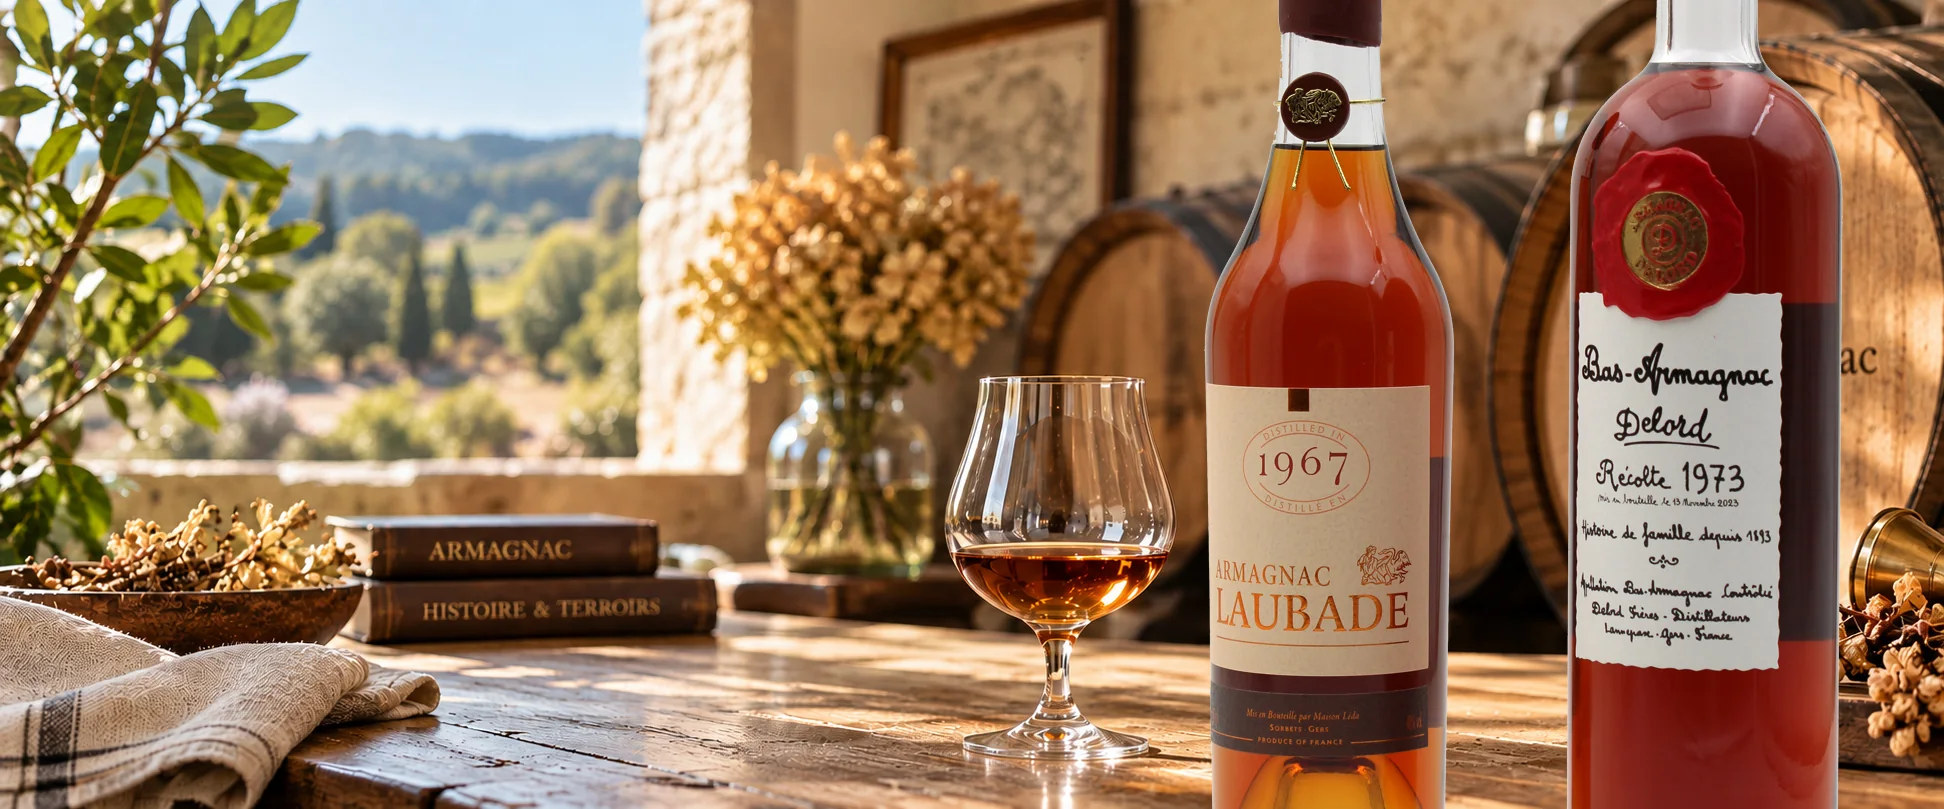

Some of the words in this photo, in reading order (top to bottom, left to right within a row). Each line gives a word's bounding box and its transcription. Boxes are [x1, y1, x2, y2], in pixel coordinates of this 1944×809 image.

[1582, 343, 1773, 402] Bas-Armagnac
[1262, 423, 1325, 441] DISTILLED
[1330, 430, 1346, 442] IN
[1614, 406, 1712, 443] Delord
[1259, 447, 1348, 486] 1967
[1596, 459, 1671, 492] Récolte
[1682, 461, 1745, 495] 1973
[1329, 494, 1347, 508] EN
[1661, 497, 1671, 506] le
[1673, 498, 1681, 506] 13
[1717, 499, 1739, 507] 2023
[1582, 520, 1617, 541] Histoire
[1622, 525, 1637, 540] de
[1642, 522, 1694, 548] famille
[1699, 526, 1742, 550] depuis
[1746, 529, 1771, 544] 1893
[429, 539, 573, 561] ARMAGNAC
[1215, 559, 1331, 586] ARMAGNAC
[423, 601, 526, 621] HISTOIRE
[534, 602, 550, 618] &
[557, 598, 661, 618] TERROIRS
[1216, 587, 1409, 632] LAUBADE
[1592, 601, 1625, 618] Delord
[1671, 608, 1750, 622] Distillateurs
[1660, 628, 1685, 646] Gers
[1695, 625, 1733, 641] France
[1268, 710, 1297, 720] Bouteille
[1298, 714, 1311, 723] par
[1313, 712, 1339, 720] Maison
[1257, 736, 1293, 745] PRODUCE
